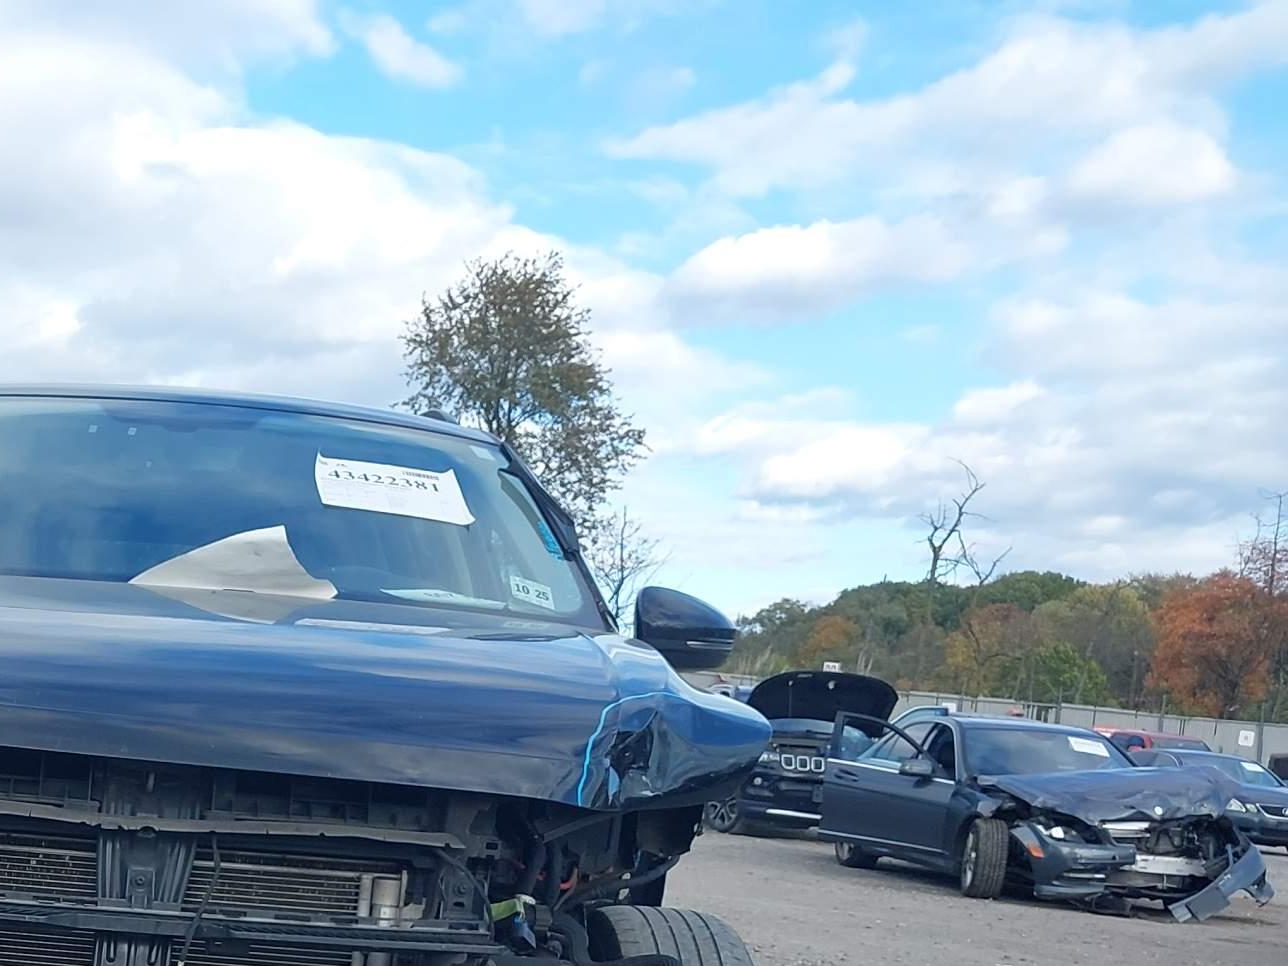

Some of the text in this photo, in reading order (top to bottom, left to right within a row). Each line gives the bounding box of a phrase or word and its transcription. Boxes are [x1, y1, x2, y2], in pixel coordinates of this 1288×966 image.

[327, 469, 440, 492] 43422381
[515, 583, 550, 601] 10 25
